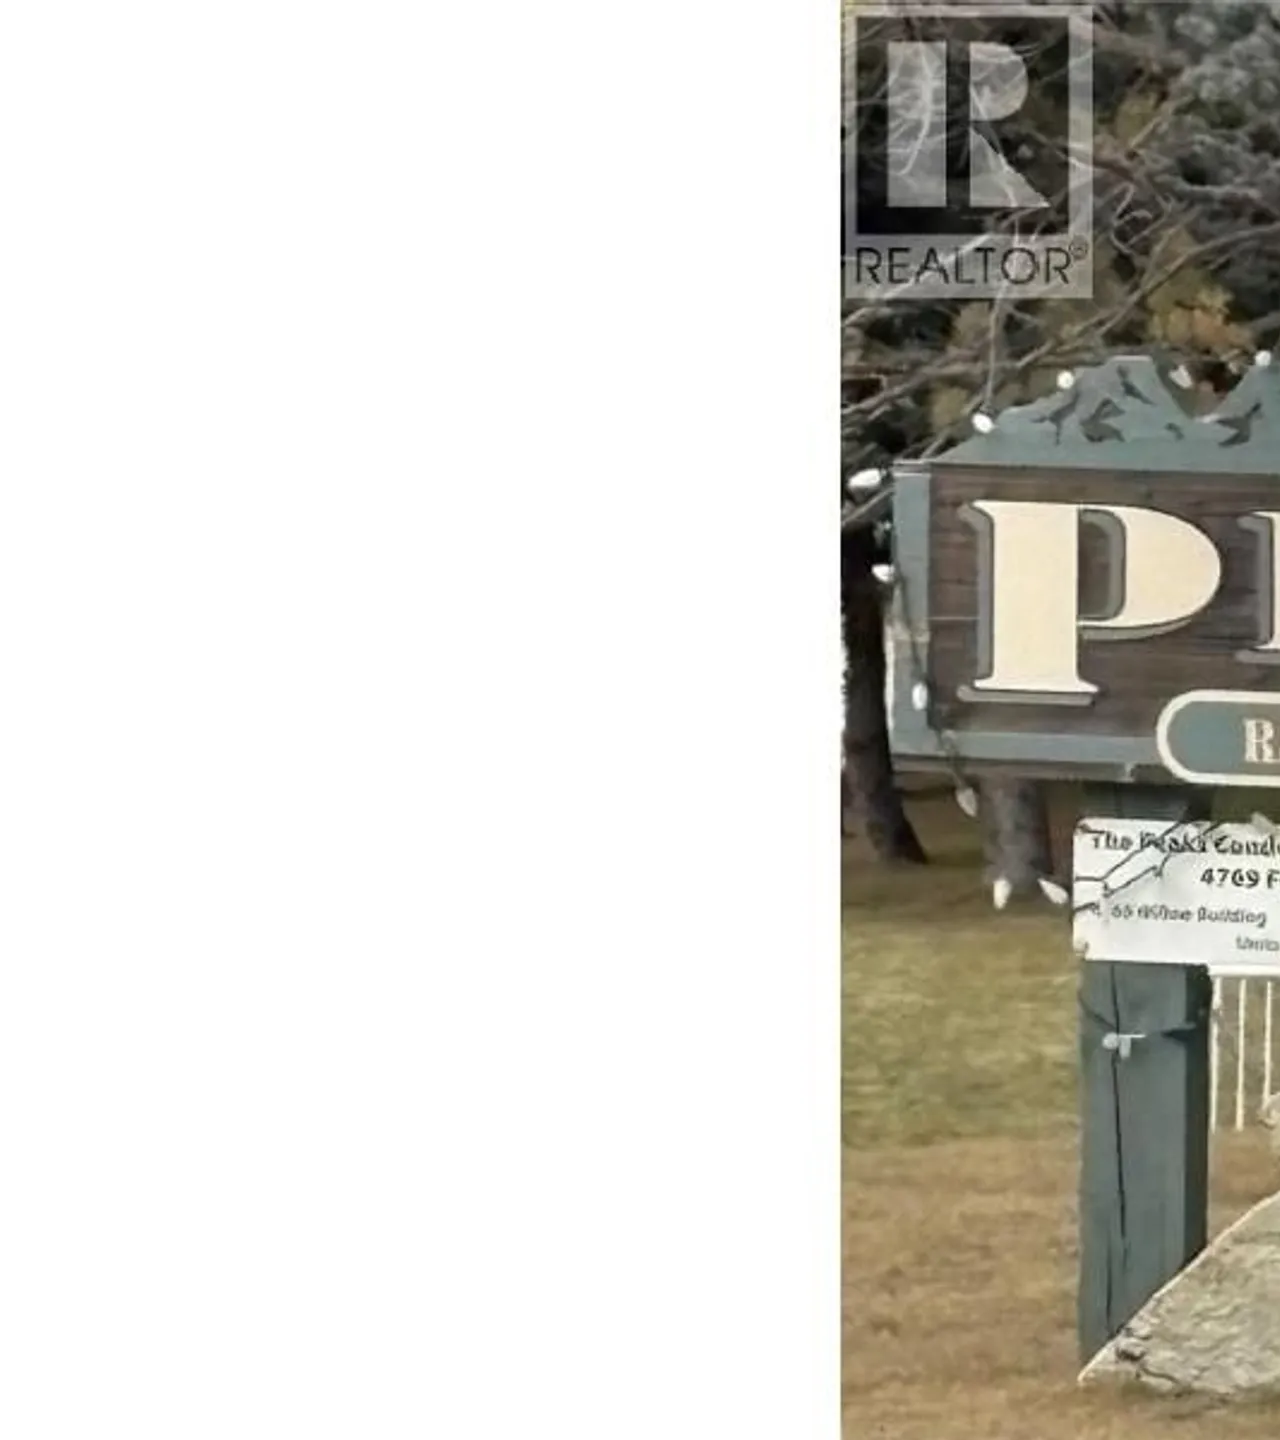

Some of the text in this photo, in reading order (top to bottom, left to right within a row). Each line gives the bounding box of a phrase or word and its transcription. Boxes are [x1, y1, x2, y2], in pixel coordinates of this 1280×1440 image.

[1093, 831, 1133, 849] The
[1200, 868, 1260, 887] 4769
[1197, 905, 1267, 928] Building
